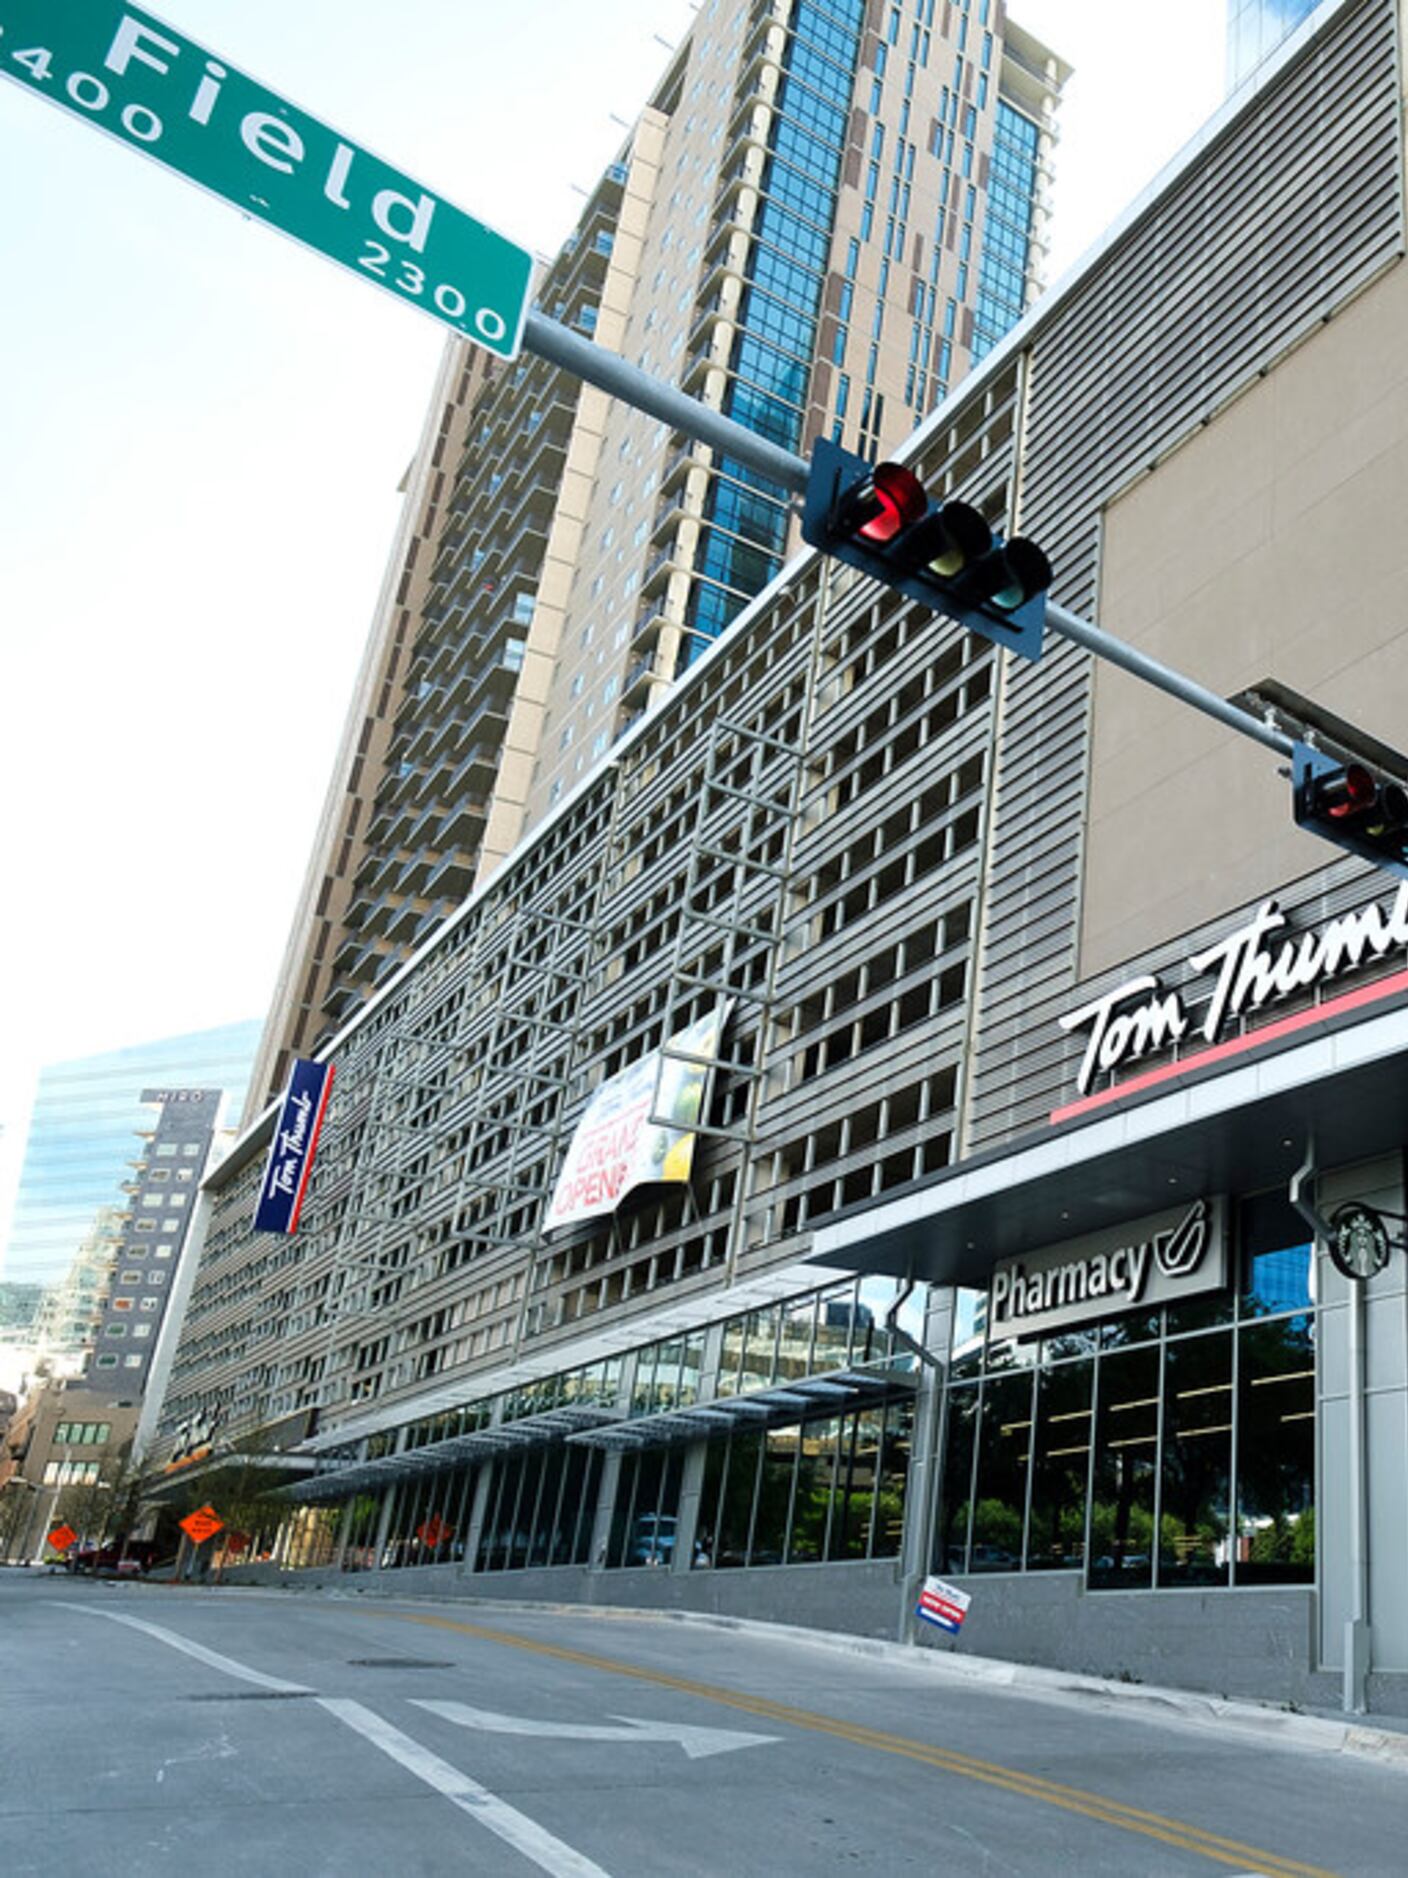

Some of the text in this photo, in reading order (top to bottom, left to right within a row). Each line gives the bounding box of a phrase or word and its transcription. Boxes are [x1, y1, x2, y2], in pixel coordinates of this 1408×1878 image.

[0, 25, 163, 142] 400
[104, 15, 436, 253] Field
[357, 240, 507, 342] 2300
[1059, 975, 1187, 1095] Tom
[268, 1090, 312, 1199] Tom Thumb
[992, 1241, 1148, 1321] Pharmacy
